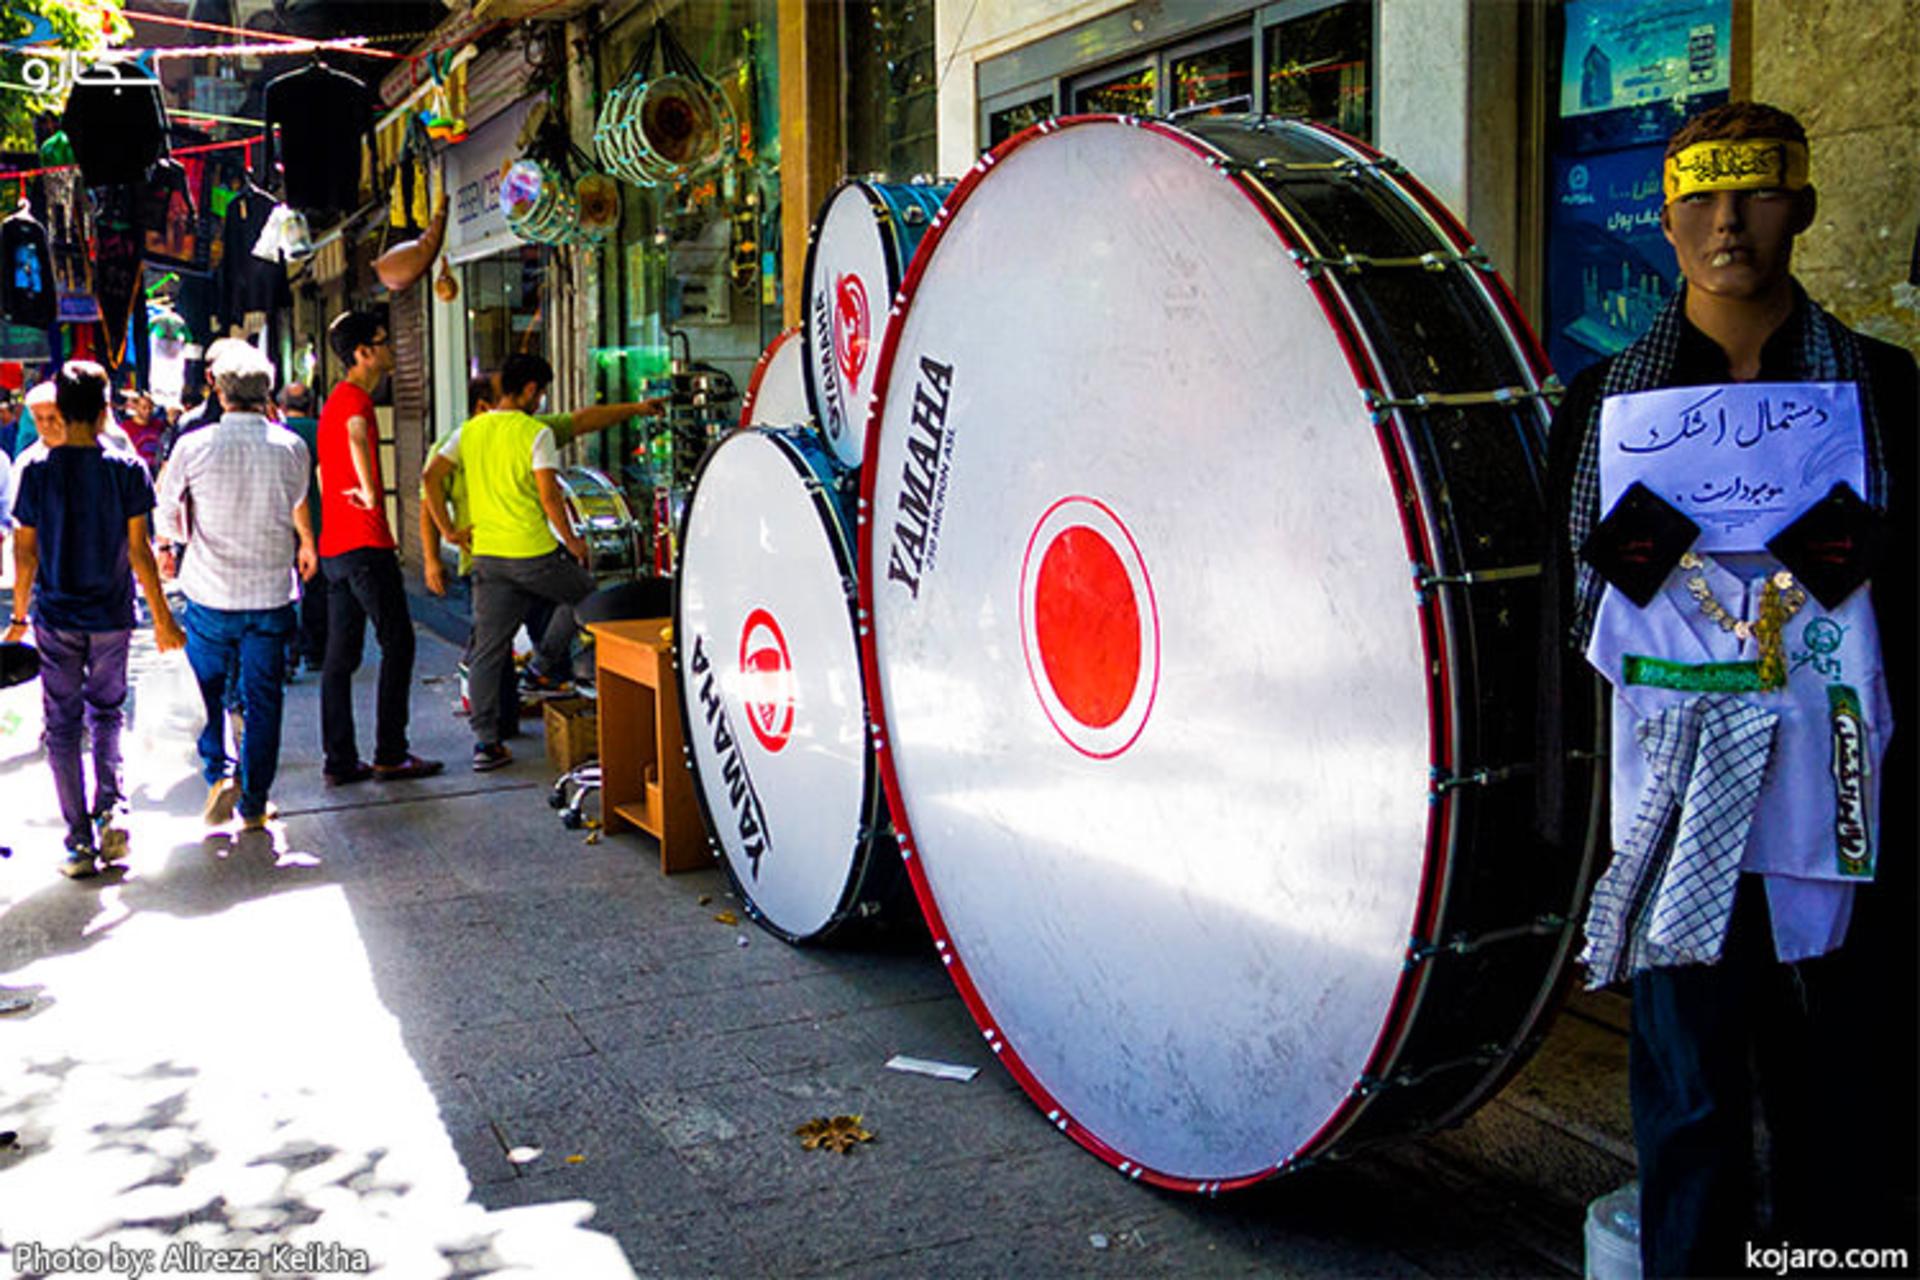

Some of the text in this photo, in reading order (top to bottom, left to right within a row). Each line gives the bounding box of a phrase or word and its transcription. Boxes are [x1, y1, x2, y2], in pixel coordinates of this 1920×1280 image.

[1607, 207, 1662, 234] یف پول
[817, 290, 836, 404] YAMAHA
[887, 355, 954, 600] YAMAHA
[1619, 389, 1829, 454] دستمال اشک
[691, 635, 765, 882] YAMAHA
